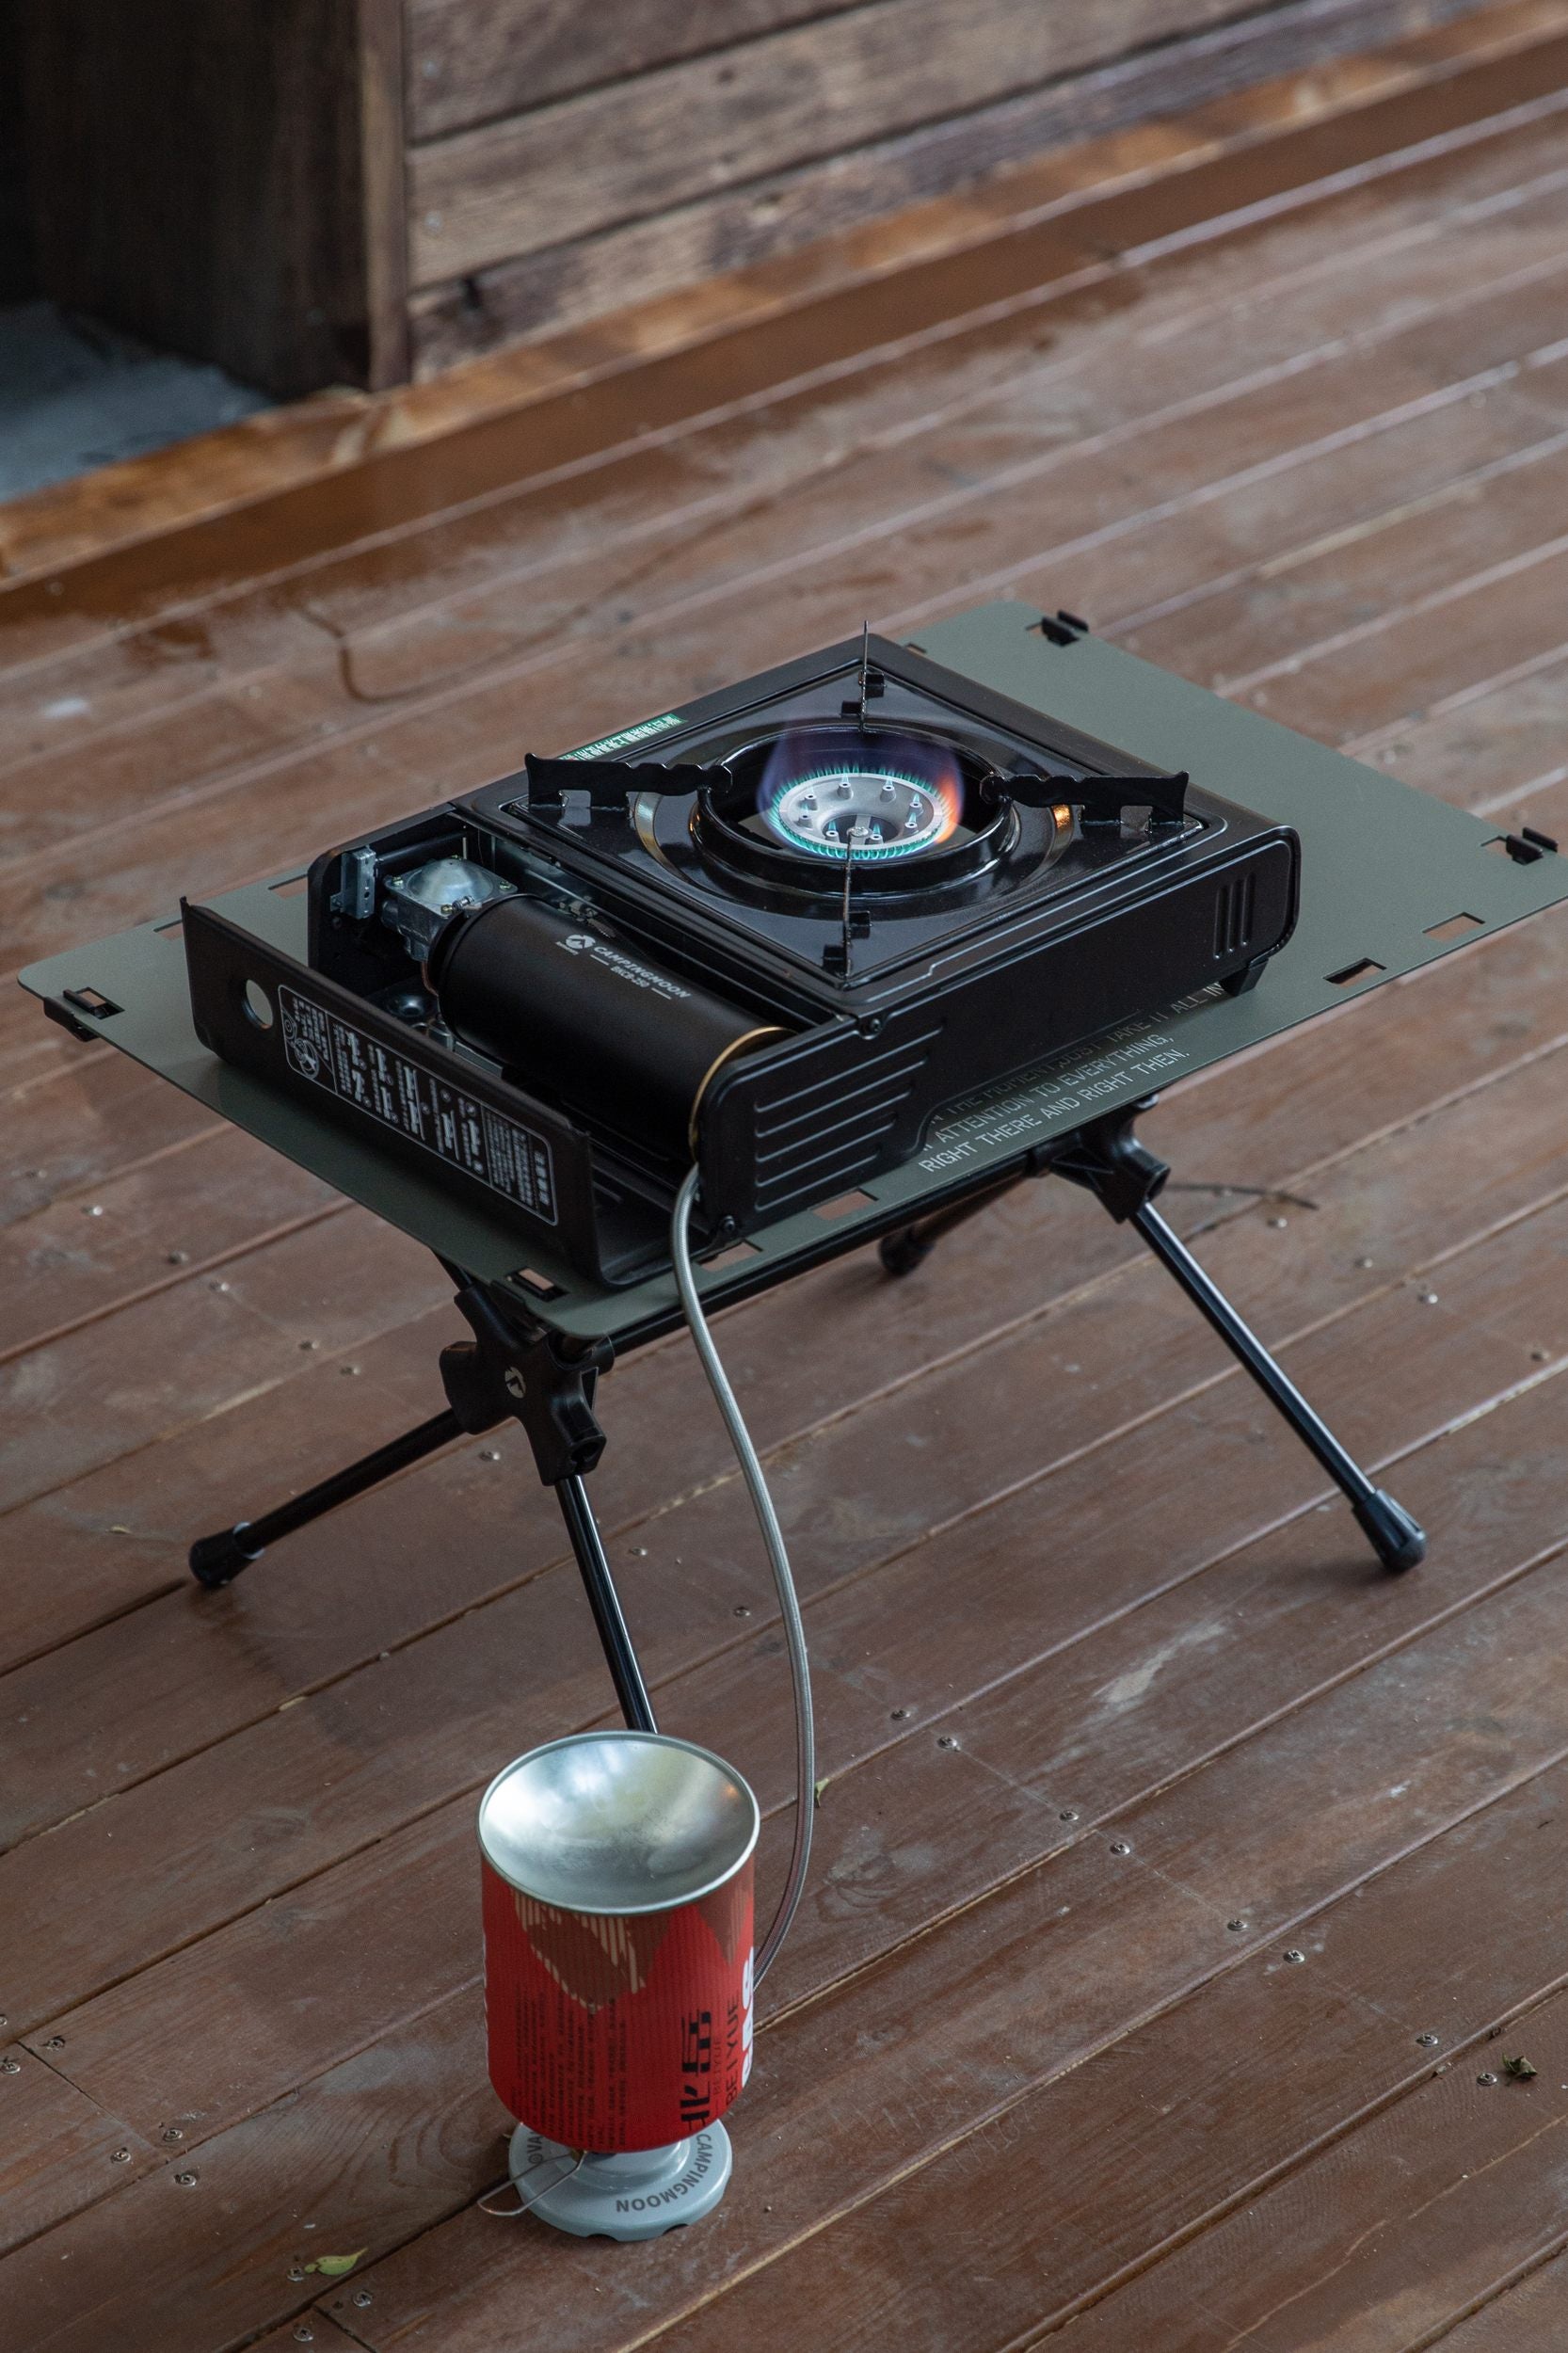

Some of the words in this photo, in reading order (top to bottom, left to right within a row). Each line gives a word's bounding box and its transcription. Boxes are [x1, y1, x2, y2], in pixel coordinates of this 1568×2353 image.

[594, 946, 691, 998] CAMPINGMOON
[1170, 995, 1208, 1014] ALL
[919, 1142, 978, 1172] RIGHT
[975, 1114, 1043, 1145] THERE
[1040, 1097, 1080, 1119] AND
[1078, 1072, 1133, 1100] RIGHT
[1130, 1051, 1190, 1076] THEN.
[934, 1094, 1035, 1143] ATTENTION
[1029, 1071, 1060, 1096] TO
[1057, 1033, 1174, 1085] EVERYTHING,
[680, 2009, 711, 2129] 北岳
[616, 2134, 712, 2213] CAMPINGMOON
